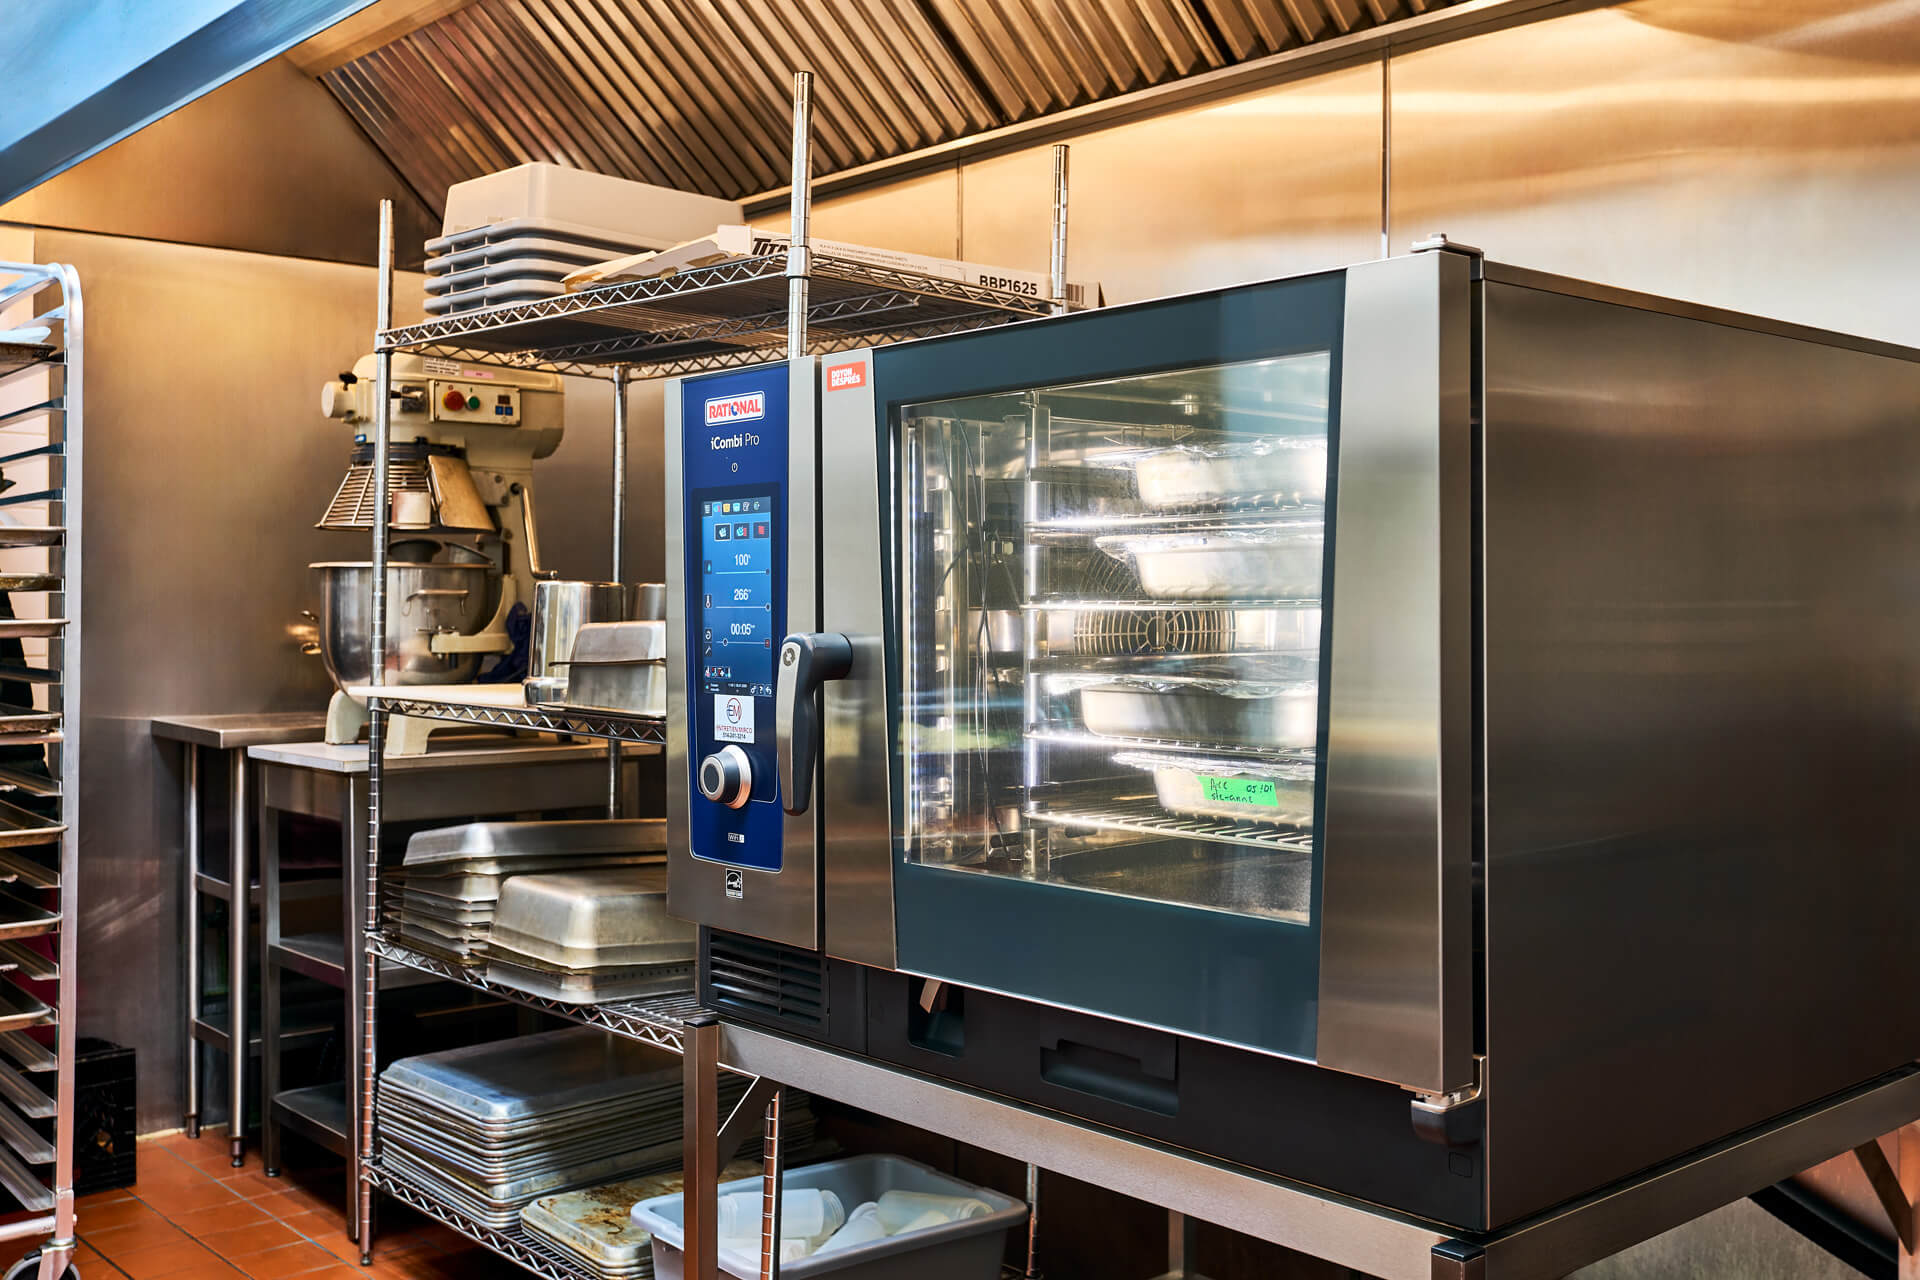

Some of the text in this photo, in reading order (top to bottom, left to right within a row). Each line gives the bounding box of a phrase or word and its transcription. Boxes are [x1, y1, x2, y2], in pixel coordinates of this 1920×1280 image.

[752, 238, 788, 256] TITA
[979, 274, 1037, 296] BBP1625
[709, 399, 761, 419] RATIONAL
[711, 432, 760, 450] iCombi Pro
